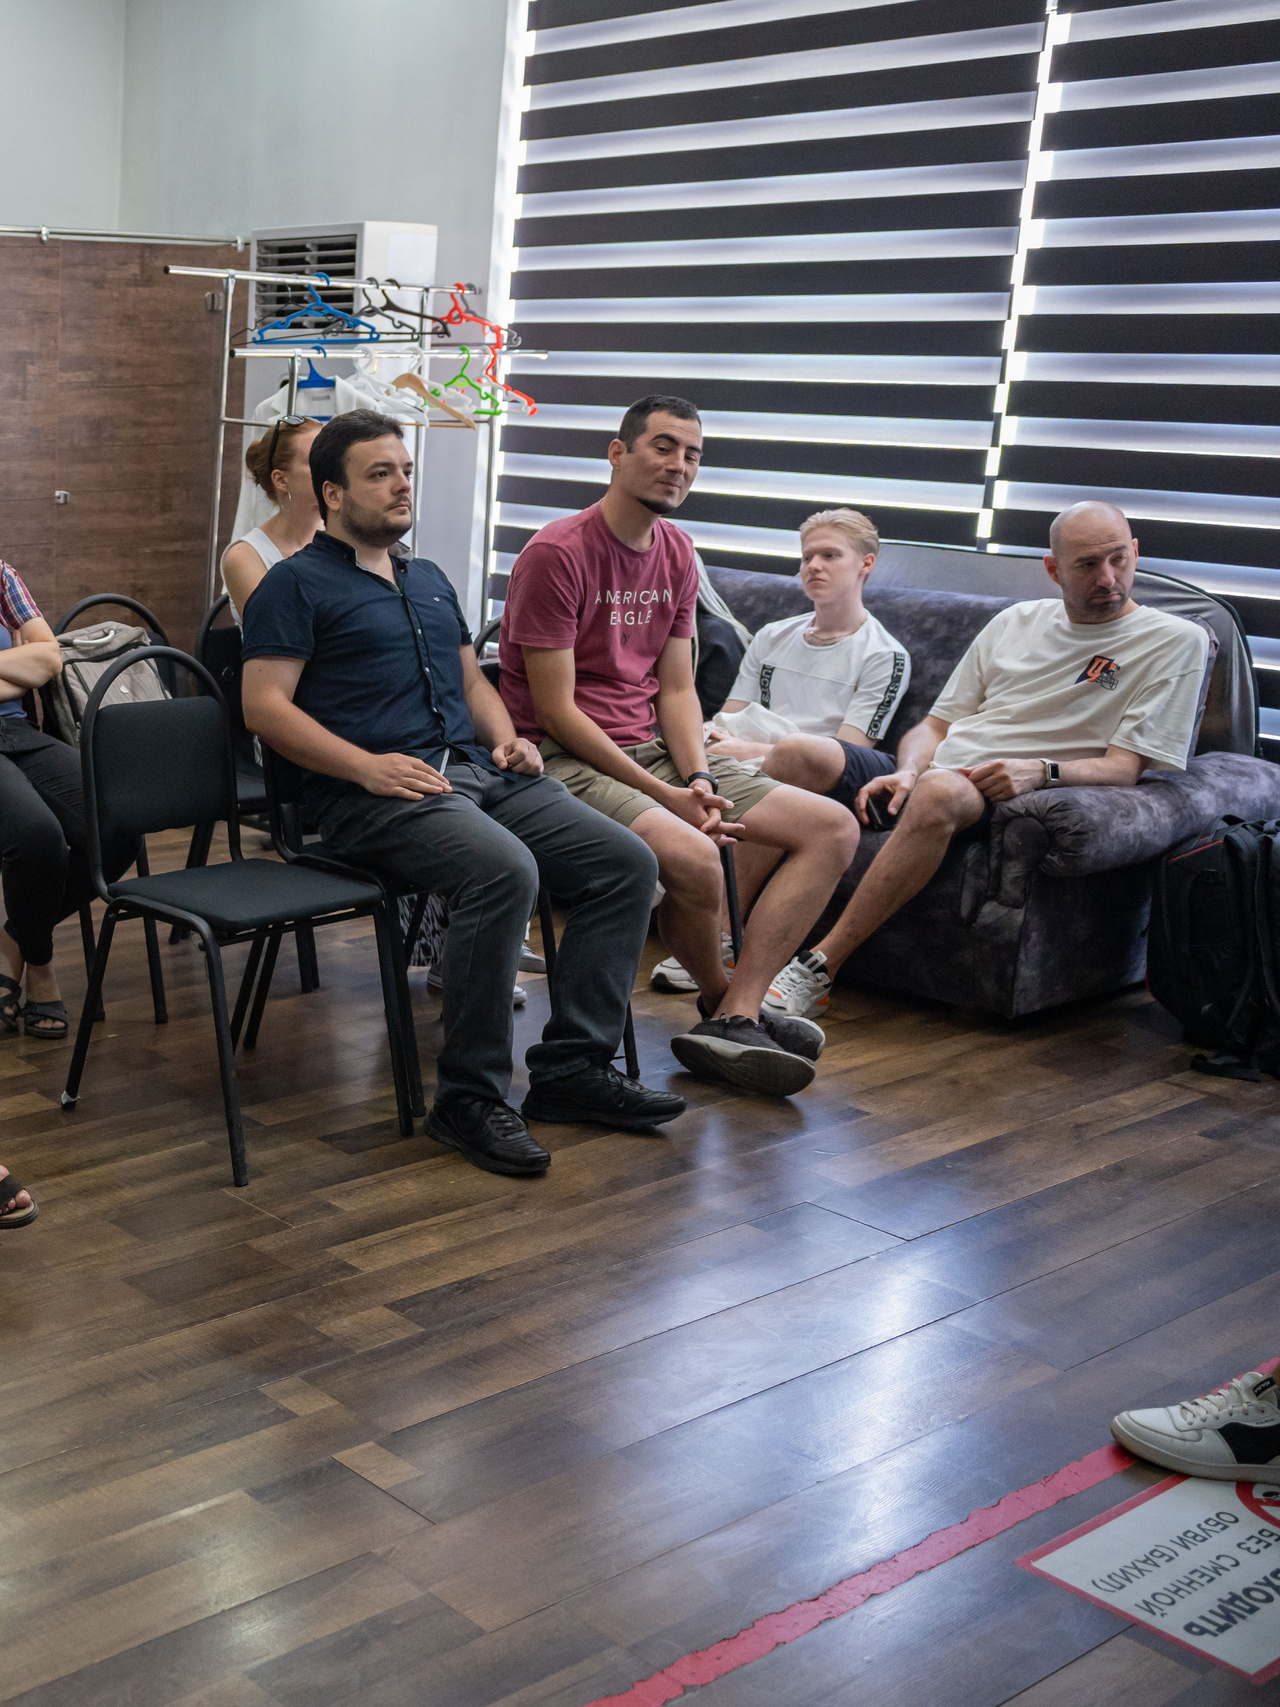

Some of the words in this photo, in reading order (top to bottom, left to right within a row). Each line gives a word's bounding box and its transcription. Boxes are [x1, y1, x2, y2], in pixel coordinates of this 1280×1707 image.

[594, 588, 673, 605] AMERICAN
[609, 609, 652, 626] EAGLE
[1169, 1511, 1240, 1550] ОБУВИ
[1236, 1528, 1280, 1555] БЕЗ
[1091, 1544, 1179, 1593] (БАХИЛ)
[1135, 1554, 1240, 1618] СМЕННОЙ
